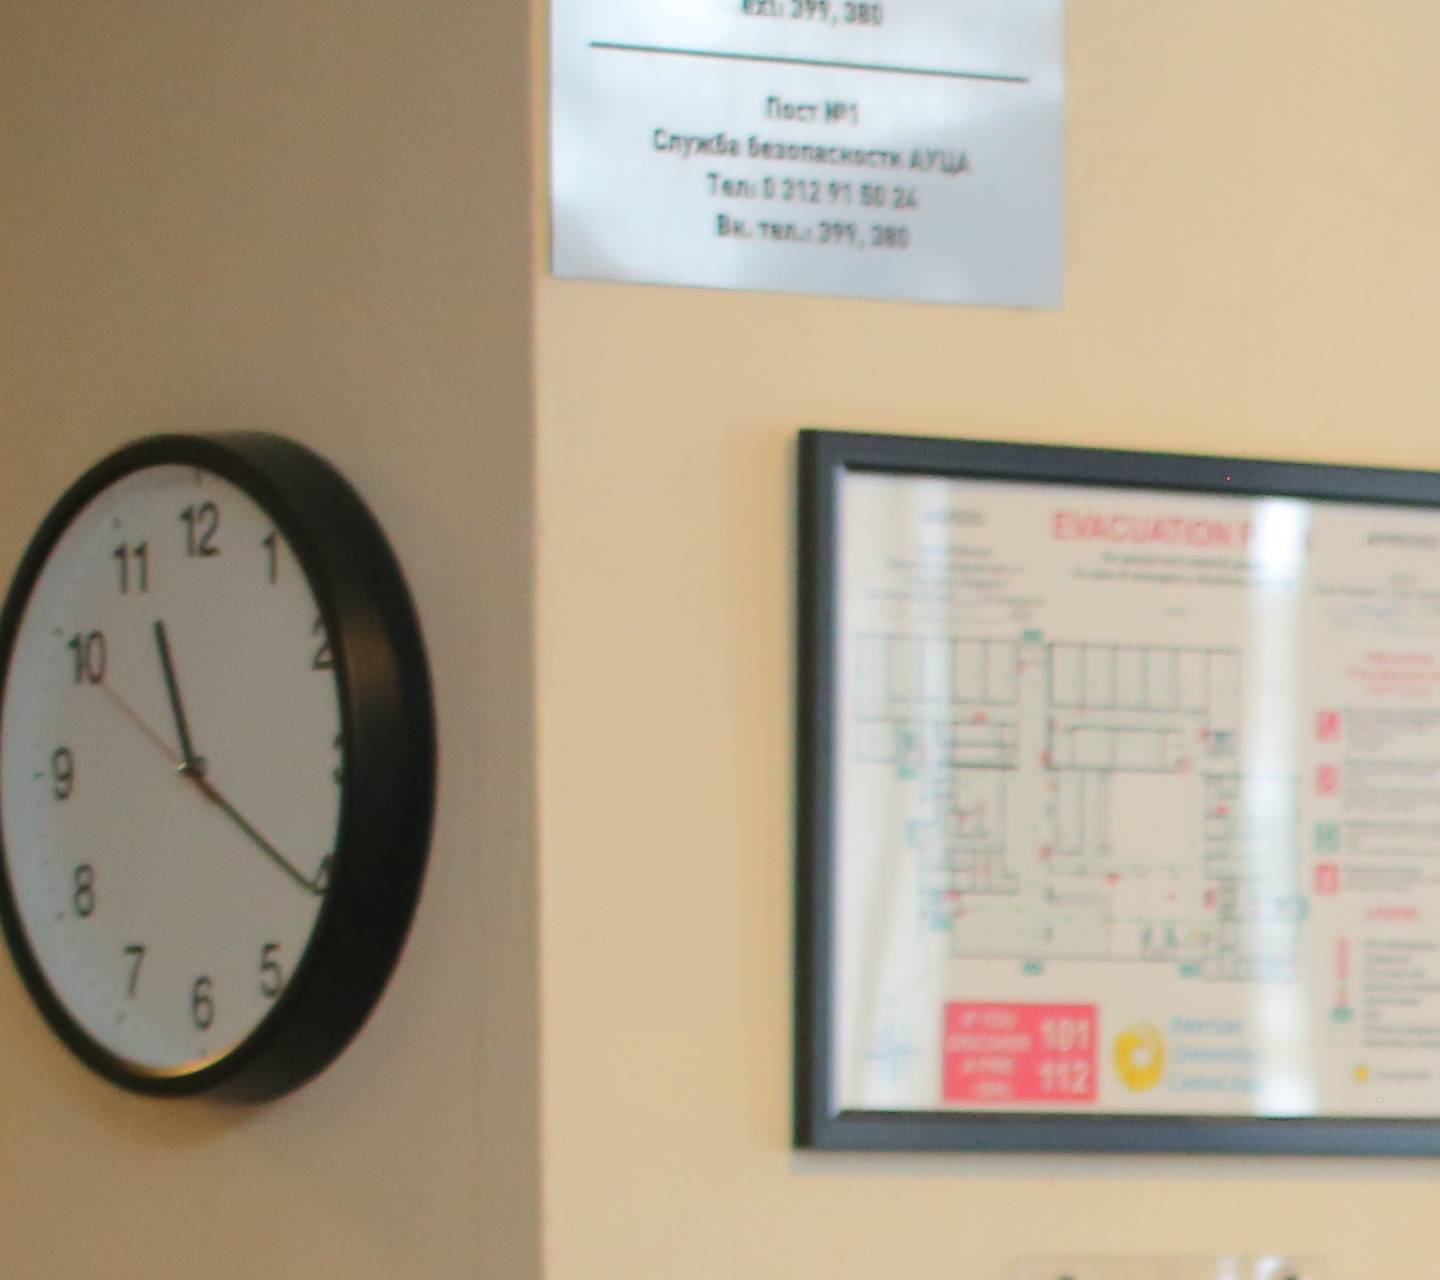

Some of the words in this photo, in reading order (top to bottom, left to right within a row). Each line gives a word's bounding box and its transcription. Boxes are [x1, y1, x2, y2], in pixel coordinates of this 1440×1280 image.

[765, 95, 818, 123] Пост
[653, 127, 741, 159] Служба
[748, 134, 901, 168] безопасности
[781, 177, 822, 204] 312
[179, 502, 220, 557] 12
[1052, 510, 1234, 547] EVACUATION
[112, 541, 148, 595] 11
[262, 530, 278, 586] 1
[67, 629, 107, 686] 10
[52, 746, 74, 801] 9
[73, 863, 95, 918] 8
[123, 944, 146, 1000] 7
[259, 941, 283, 998] 5
[191, 975, 216, 1032] 6
